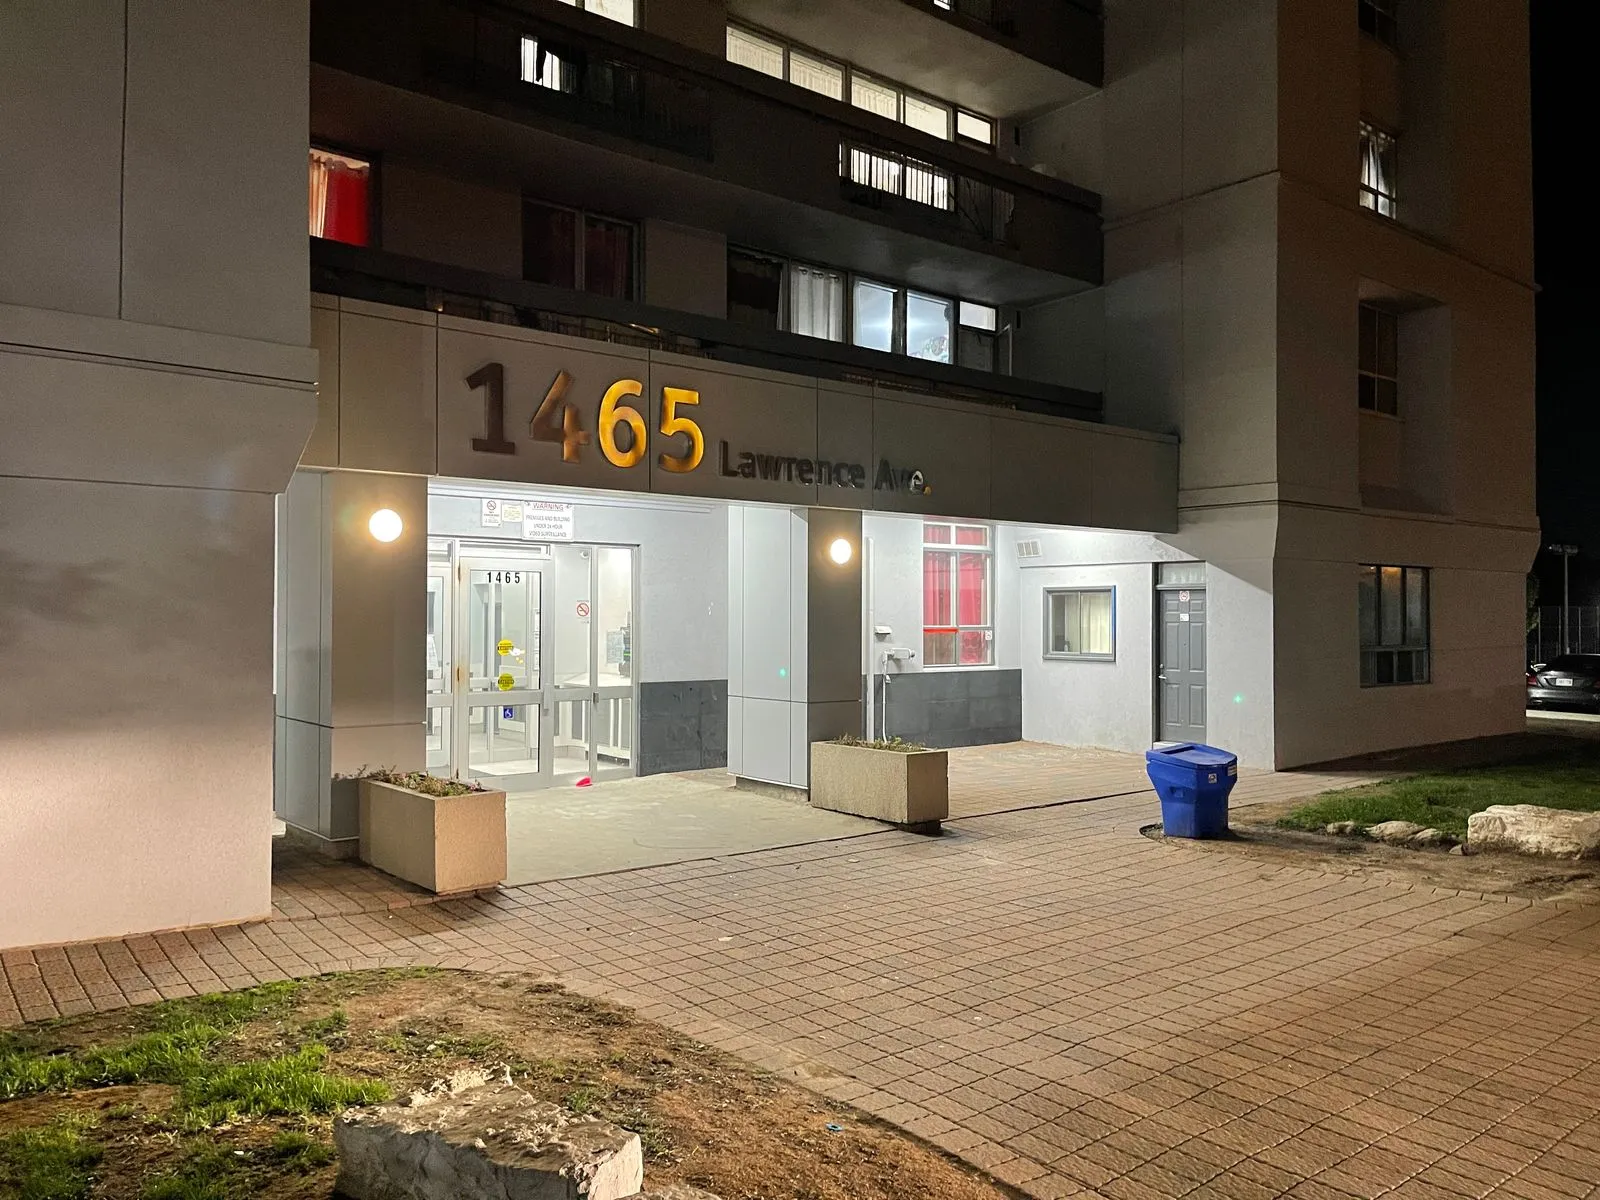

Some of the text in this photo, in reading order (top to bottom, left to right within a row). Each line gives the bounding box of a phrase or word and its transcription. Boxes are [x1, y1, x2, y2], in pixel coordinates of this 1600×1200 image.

[464, 362, 705, 473] 1465
[718, 440, 933, 496] Lawrence Ave.
[532, 502, 564, 511] WARNING
[487, 571, 521, 584] 1465
